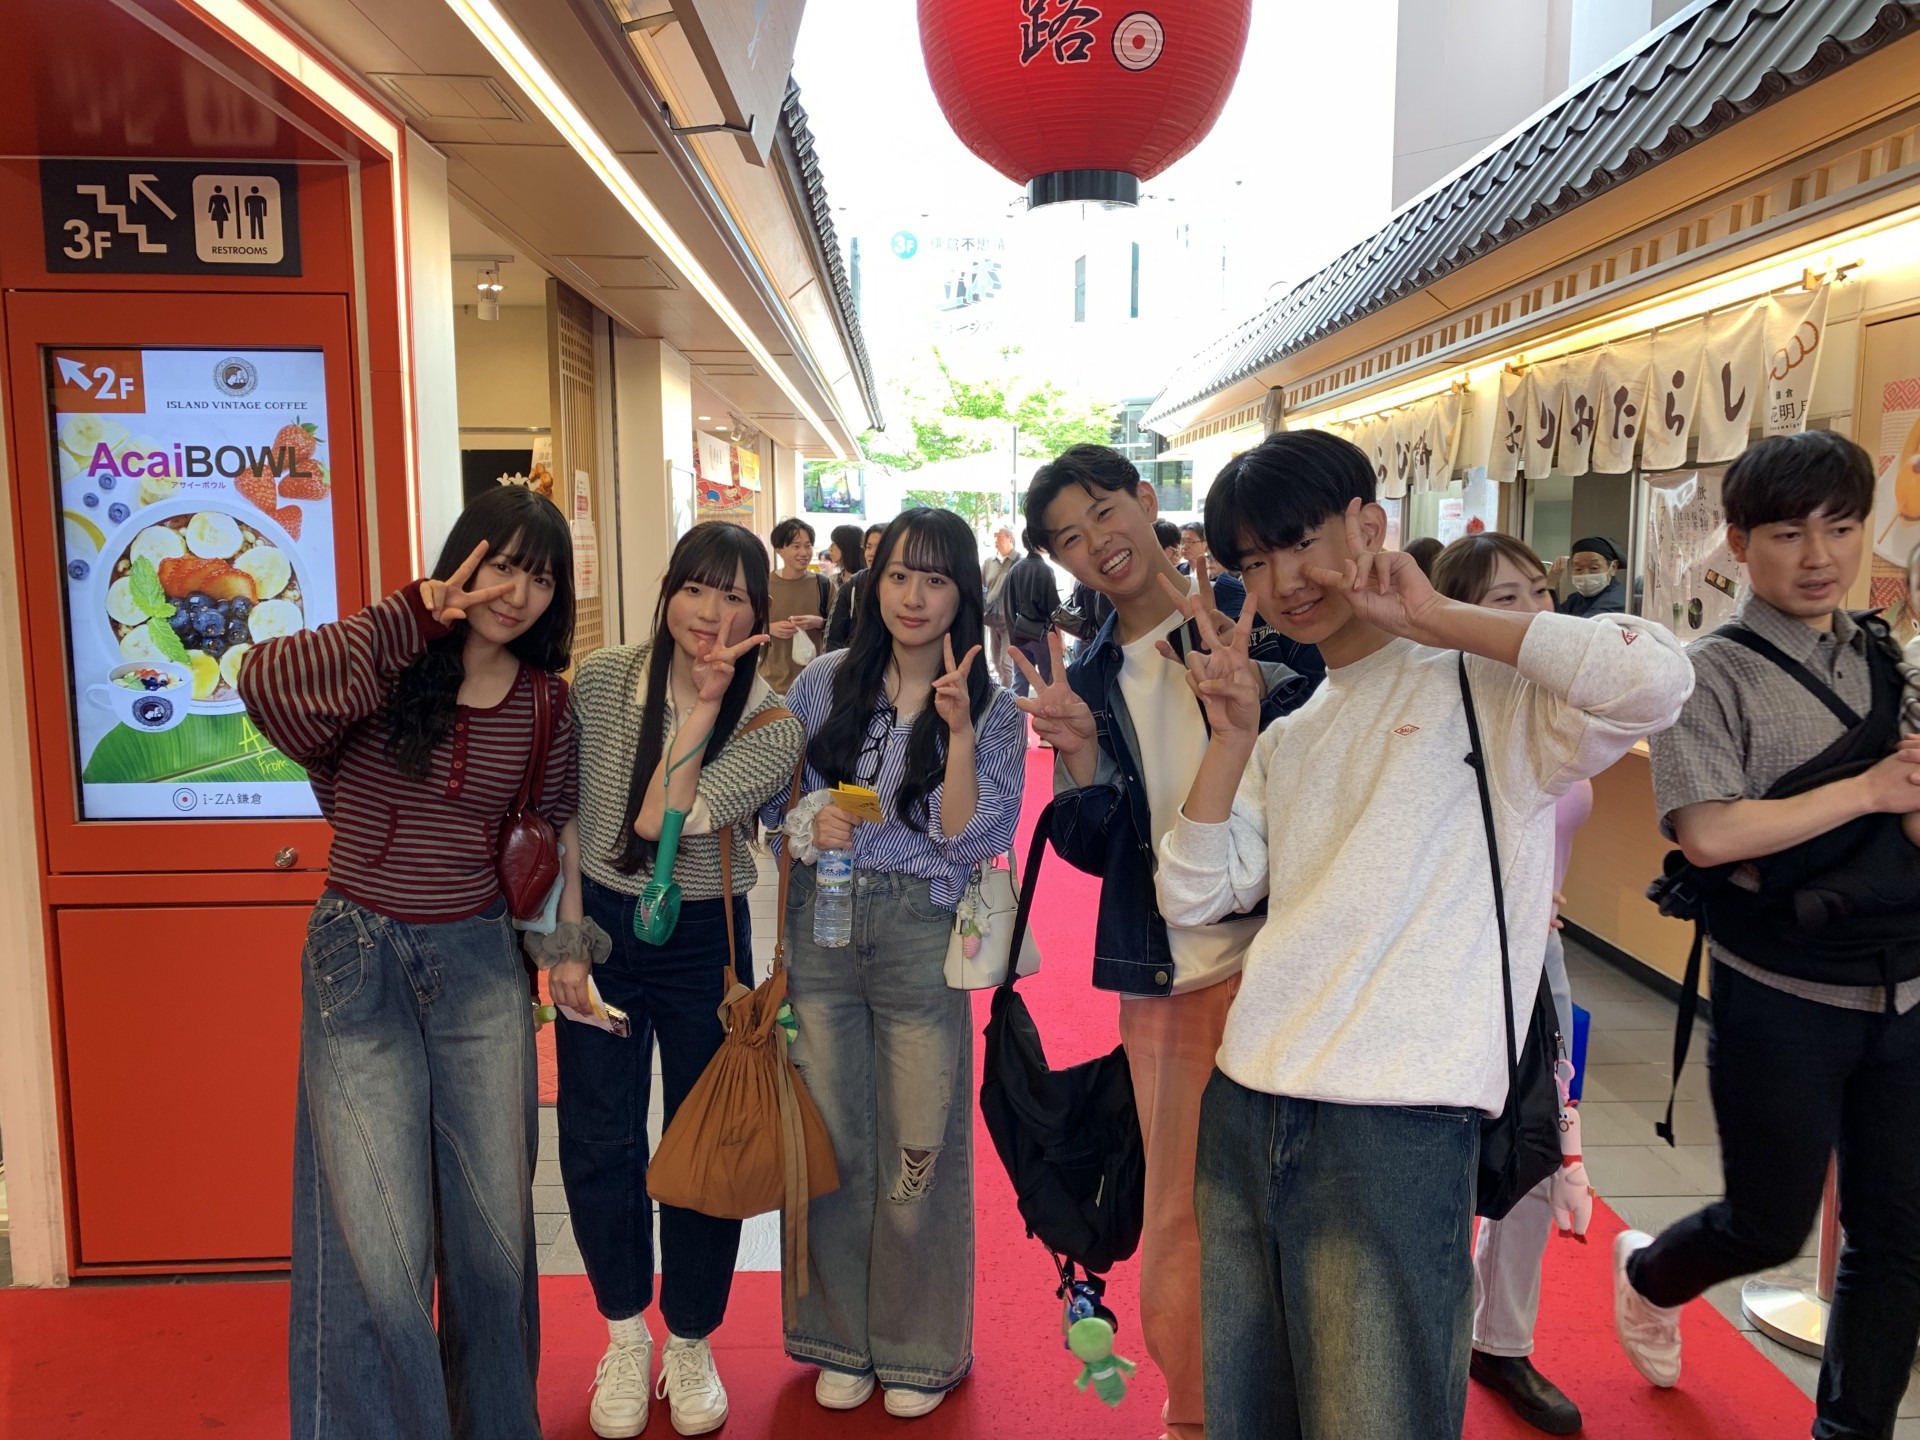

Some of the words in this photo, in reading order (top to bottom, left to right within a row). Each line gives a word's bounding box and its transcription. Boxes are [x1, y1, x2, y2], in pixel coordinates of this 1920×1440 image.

[1020, 0, 1102, 67] 路
[62, 219, 112, 260] 3F
[894, 234, 916, 255] 3F
[211, 246, 268, 256] RESTROOMS
[93, 366, 134, 400] 2F
[166, 400, 209, 409] ISLAND
[212, 401, 261, 410] VINTAGE
[264, 401, 308, 410] COFFEE
[87, 441, 313, 478] AcaiBOWL
[171, 481, 226, 489] アサイーボウル
[256, 753, 289, 775] From
